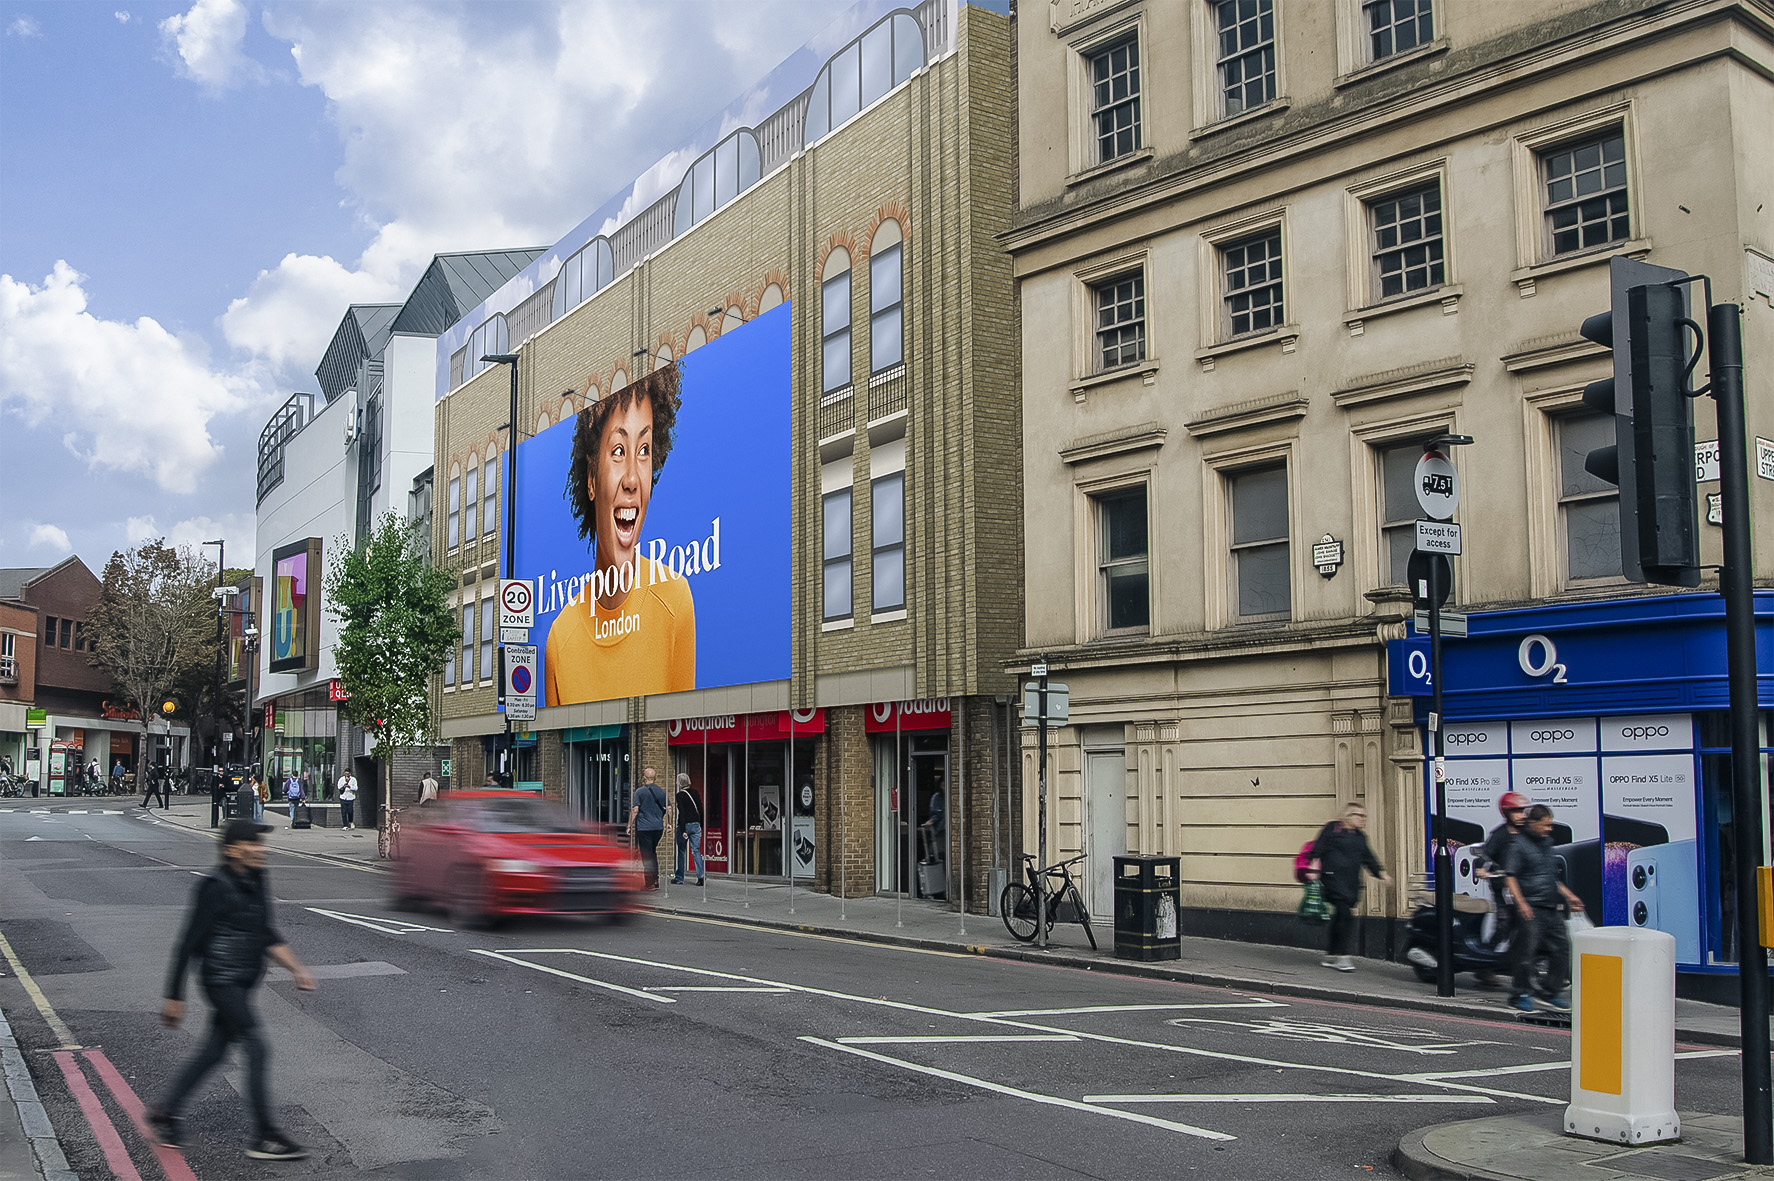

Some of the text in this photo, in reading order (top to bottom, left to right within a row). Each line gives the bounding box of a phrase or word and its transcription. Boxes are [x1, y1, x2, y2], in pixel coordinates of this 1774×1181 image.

[1419, 525, 1458, 538] Except for
[1426, 539, 1451, 549] access
[536, 516, 721, 618] Liverpool Road
[506, 591, 527, 605] 20
[503, 615, 530, 624] ZONE
[595, 610, 640, 640] London
[507, 646, 535, 655] Controlled
[511, 655, 531, 664] ZONE
[1530, 729, 1575, 743] oppo
[1621, 725, 1669, 740] oppo
[1446, 732, 1488, 746] oppo
[1455, 777, 1469, 785] Find
[1470, 777, 1479, 785] X5
[1480, 777, 1490, 785] Pro
[1525, 776, 1544, 784] OPPO
[1546, 776, 1560, 784] Find
[1562, 776, 1571, 784] X5
[1609, 775, 1630, 783] OPPO
[1631, 775, 1646, 783] Find
[1648, 775, 1659, 783] X5
[1660, 775, 1673, 783] Lite
